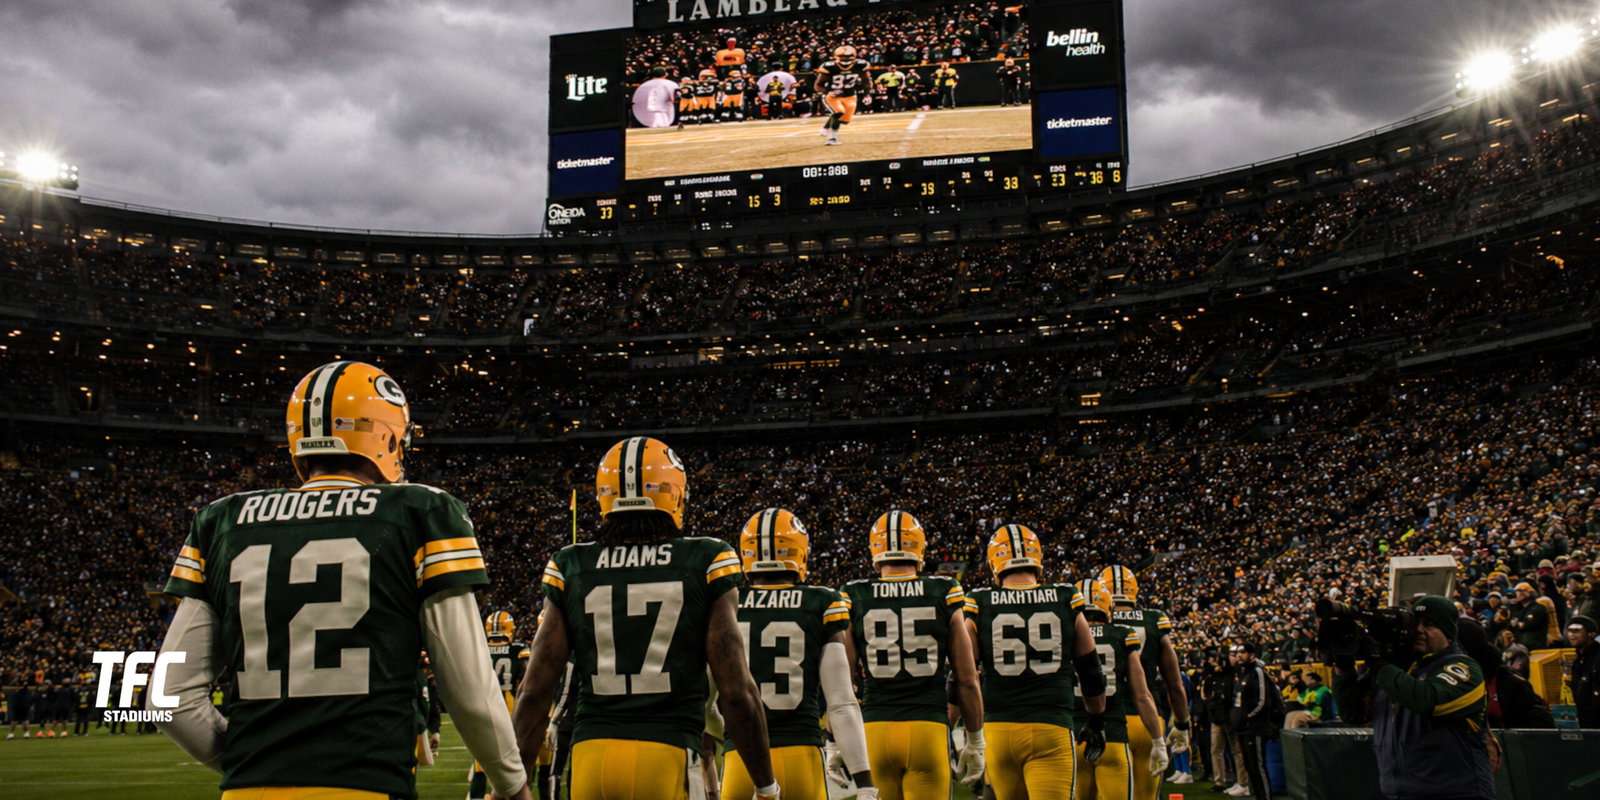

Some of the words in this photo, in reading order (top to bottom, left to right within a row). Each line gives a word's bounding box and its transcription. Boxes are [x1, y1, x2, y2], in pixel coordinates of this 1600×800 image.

[667, 0, 848, 23] LAMBE
[1046, 28, 1099, 47] bellin
[1066, 42, 1105, 56] health
[565, 75, 608, 101] Lite
[1046, 117, 1112, 129] ticketmaster
[556, 156, 615, 169] ticketmaster
[548, 207, 586, 219] ONEIDA
[237, 489, 381, 524] RODGERS
[596, 543, 673, 569] ADAMS
[872, 581, 924, 598] TONYAN
[991, 588, 1058, 605] BAKHTIARI
[229, 537, 371, 700] 12
[584, 581, 684, 696] 17
[863, 606, 939, 679] 85
[992, 611, 1063, 677] 69
